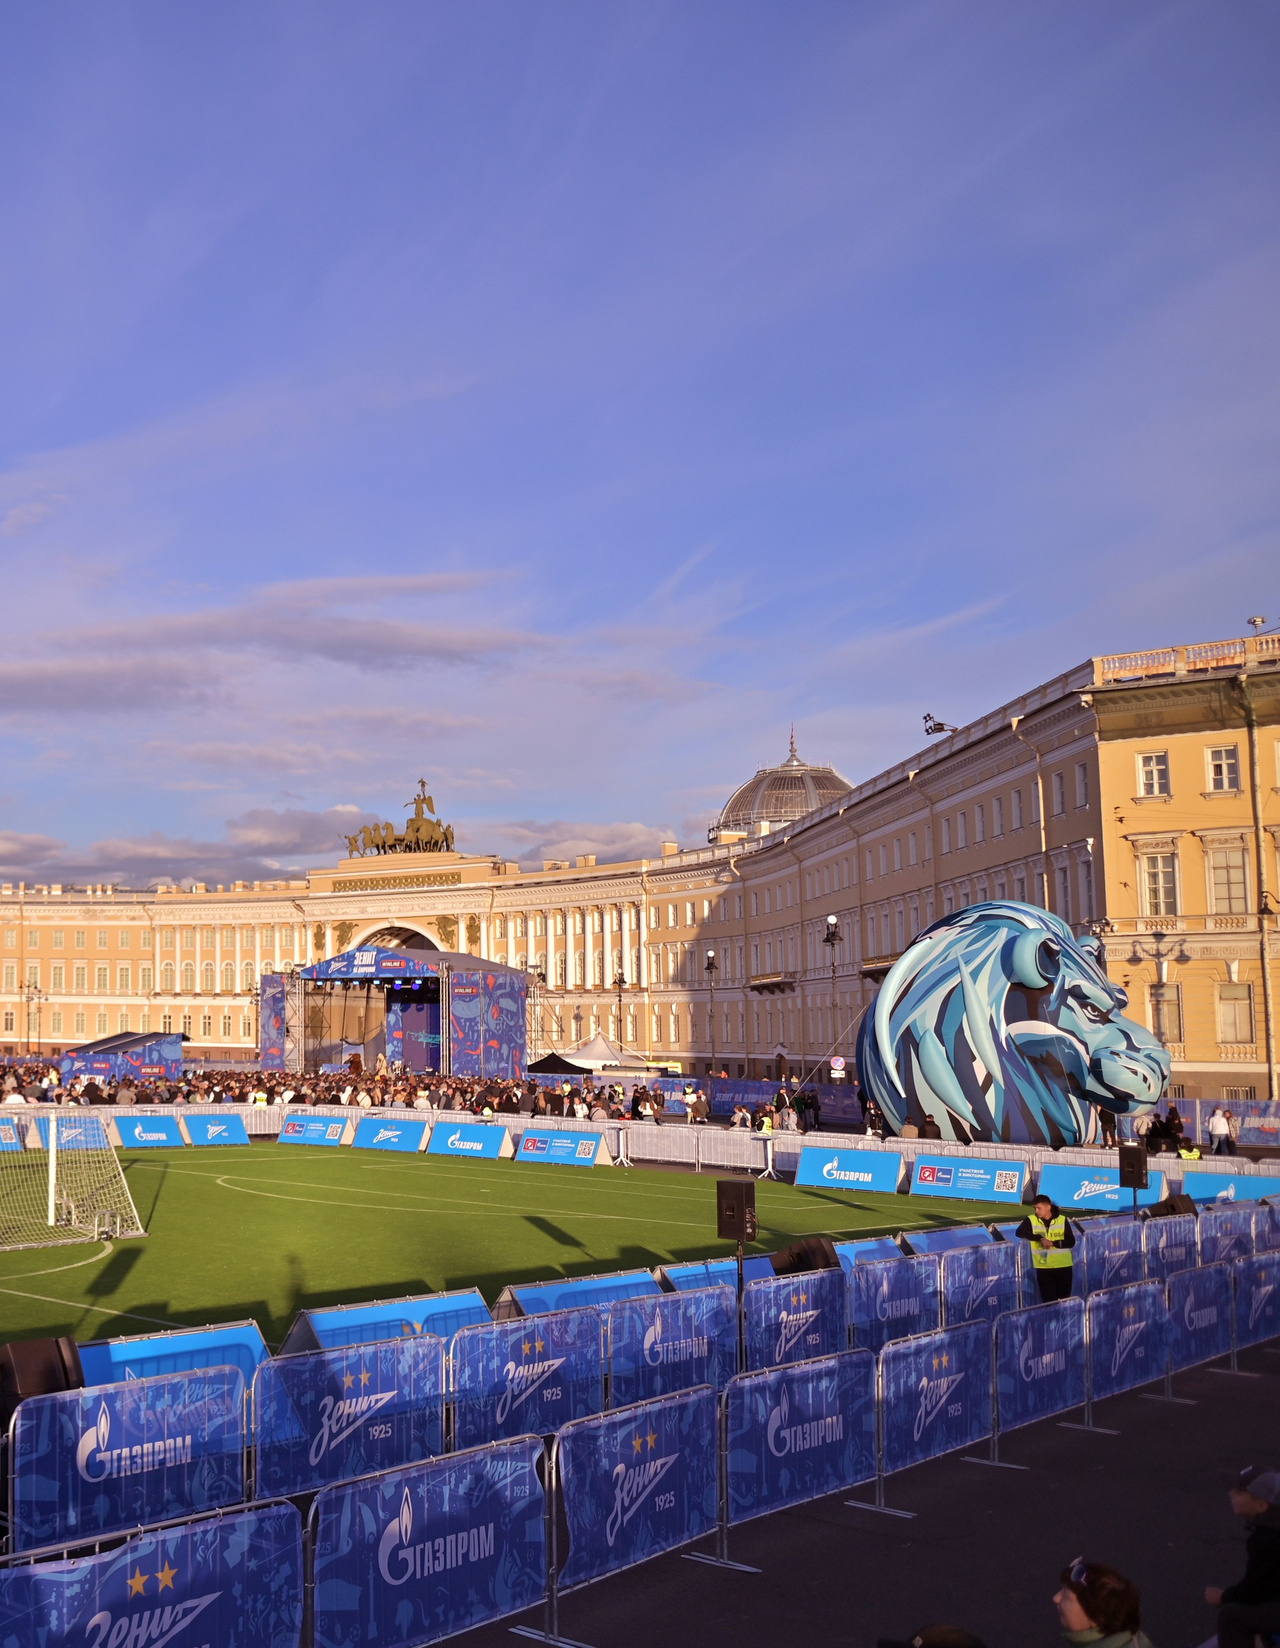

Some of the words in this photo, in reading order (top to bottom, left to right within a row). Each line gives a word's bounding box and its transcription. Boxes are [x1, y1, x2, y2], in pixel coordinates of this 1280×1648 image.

[354, 952, 377, 965] ЗЕНИТ
[836, 1170, 872, 1182] ГАЗПРОМ
[887, 1297, 920, 1320] ГАЗПРОМ
[806, 1333, 820, 1345] 1925
[663, 1335, 708, 1365] ГАЗПРОМ
[1034, 1349, 1066, 1380] ГАЗПРОМ
[542, 1387, 562, 1402] 1925
[210, 1404, 227, 1415] 1925
[948, 1403, 962, 1418] 1925
[368, 1423, 393, 1440] 1925
[789, 1414, 844, 1454] ГАЗПРОМ
[15, 1443, 31, 1454] 925
[111, 1434, 192, 1478] ГАЗПРОМ
[513, 1485, 529, 1497] 1925
[654, 1491, 675, 1512] 1925
[415, 1522, 495, 1580] ГАЗПРОМ
